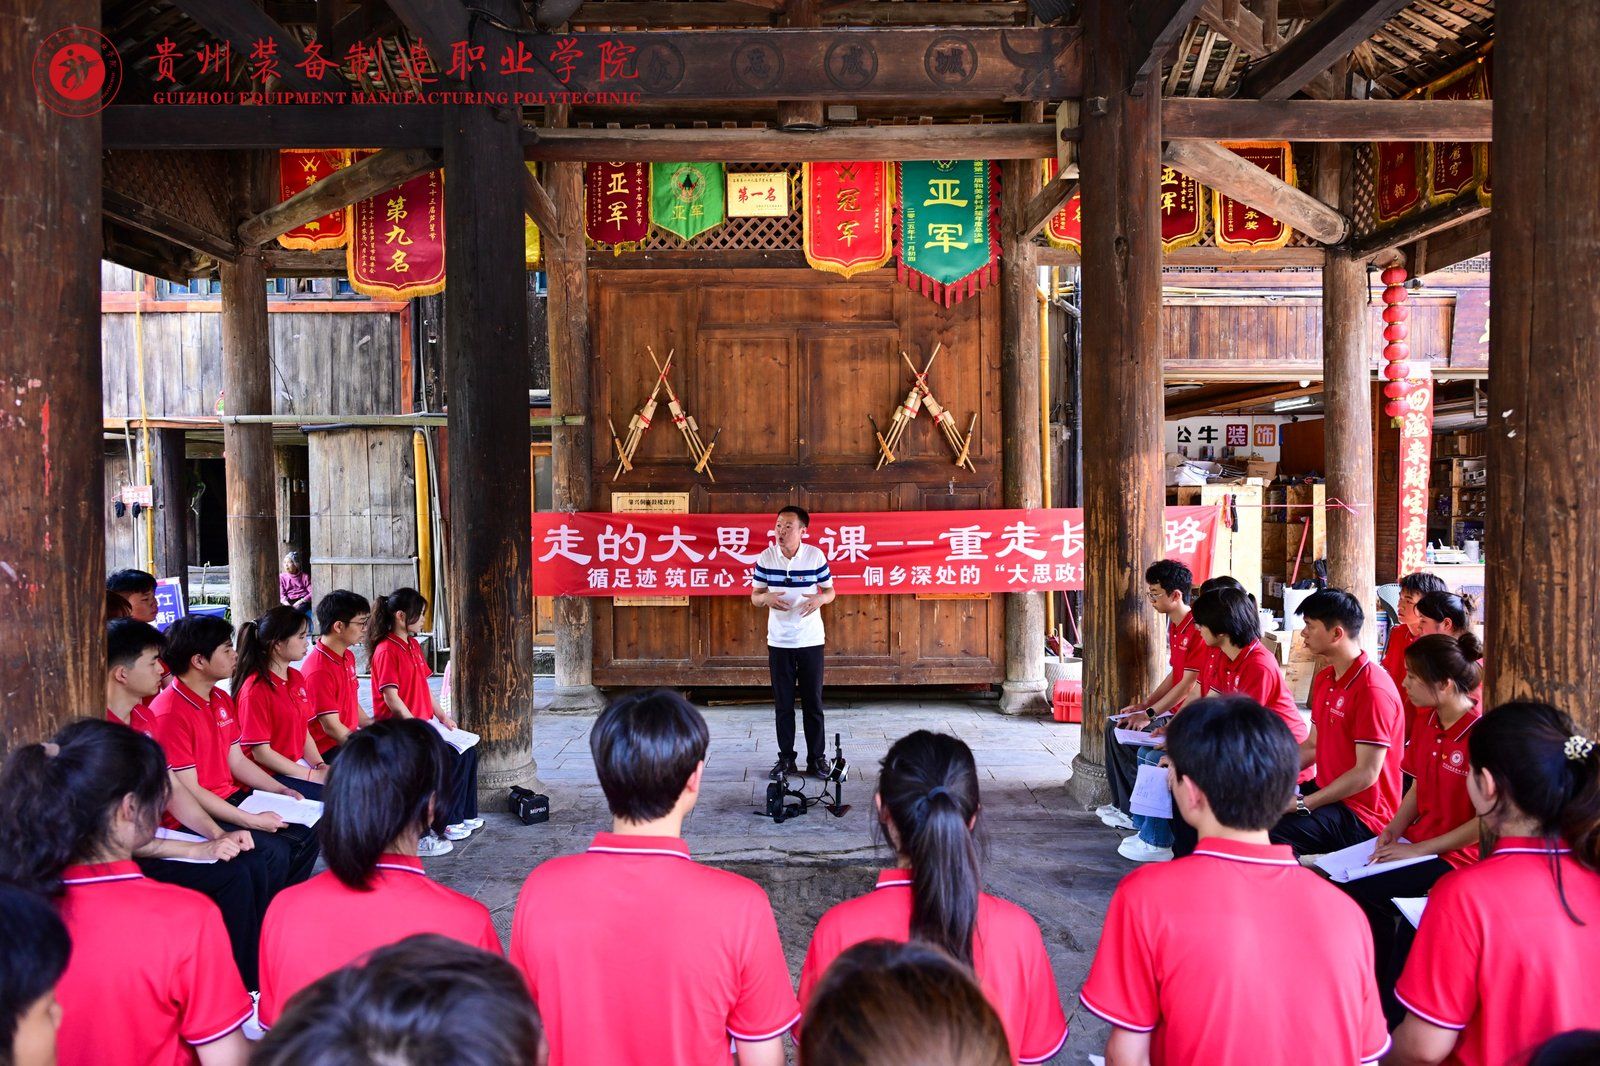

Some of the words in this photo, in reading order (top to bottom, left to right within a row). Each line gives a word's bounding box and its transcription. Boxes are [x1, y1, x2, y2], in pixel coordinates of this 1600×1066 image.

[605, 171, 631, 231] 亚军
[671, 204, 705, 221] 亚军
[738, 186, 777, 204] 第一名
[835, 187, 862, 248] 冠军
[922, 178, 970, 254] 亚军
[385, 195, 414, 273] 第九名
[587, 567, 657, 589] 循足迹
[665, 567, 735, 589] 筑匠心
